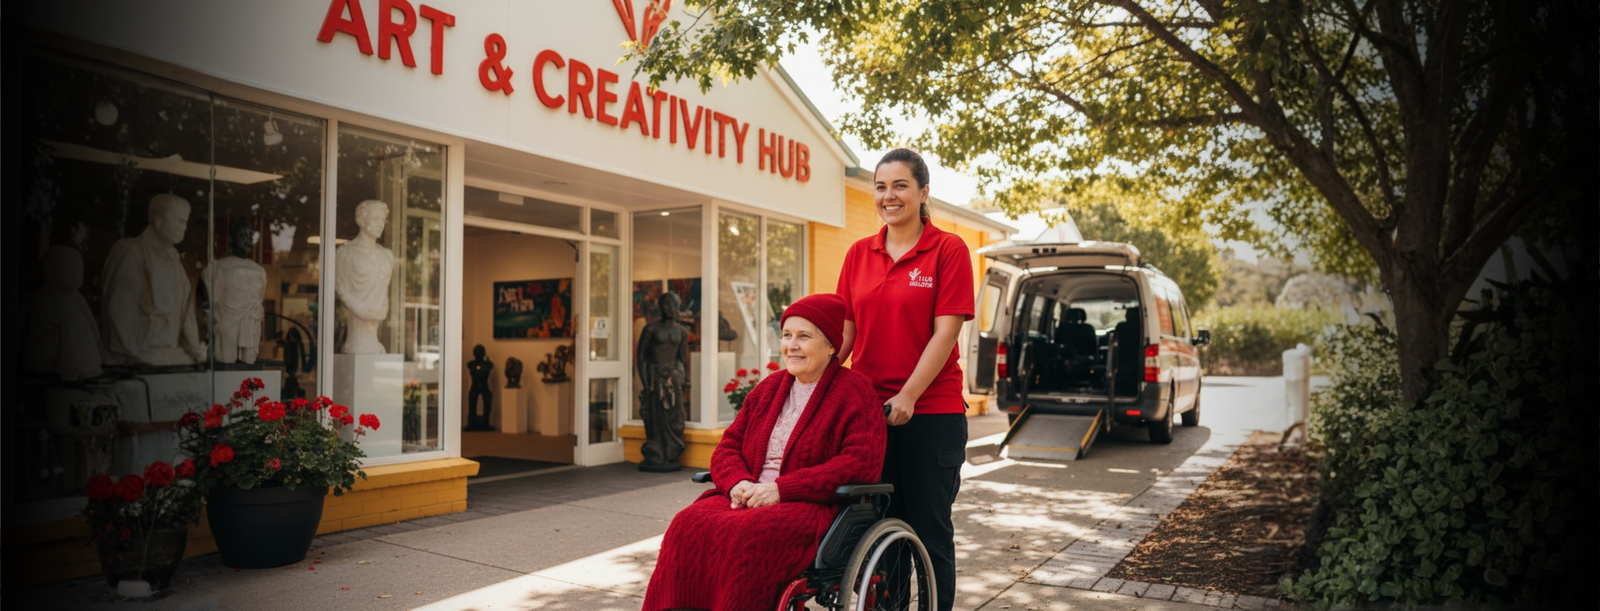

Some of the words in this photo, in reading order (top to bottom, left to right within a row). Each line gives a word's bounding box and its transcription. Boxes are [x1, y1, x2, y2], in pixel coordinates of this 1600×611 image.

[317, 0, 455, 75] ART
[478, 33, 514, 95] &
[532, 49, 750, 164] CREATIVITY
[759, 128, 811, 182] HUB
